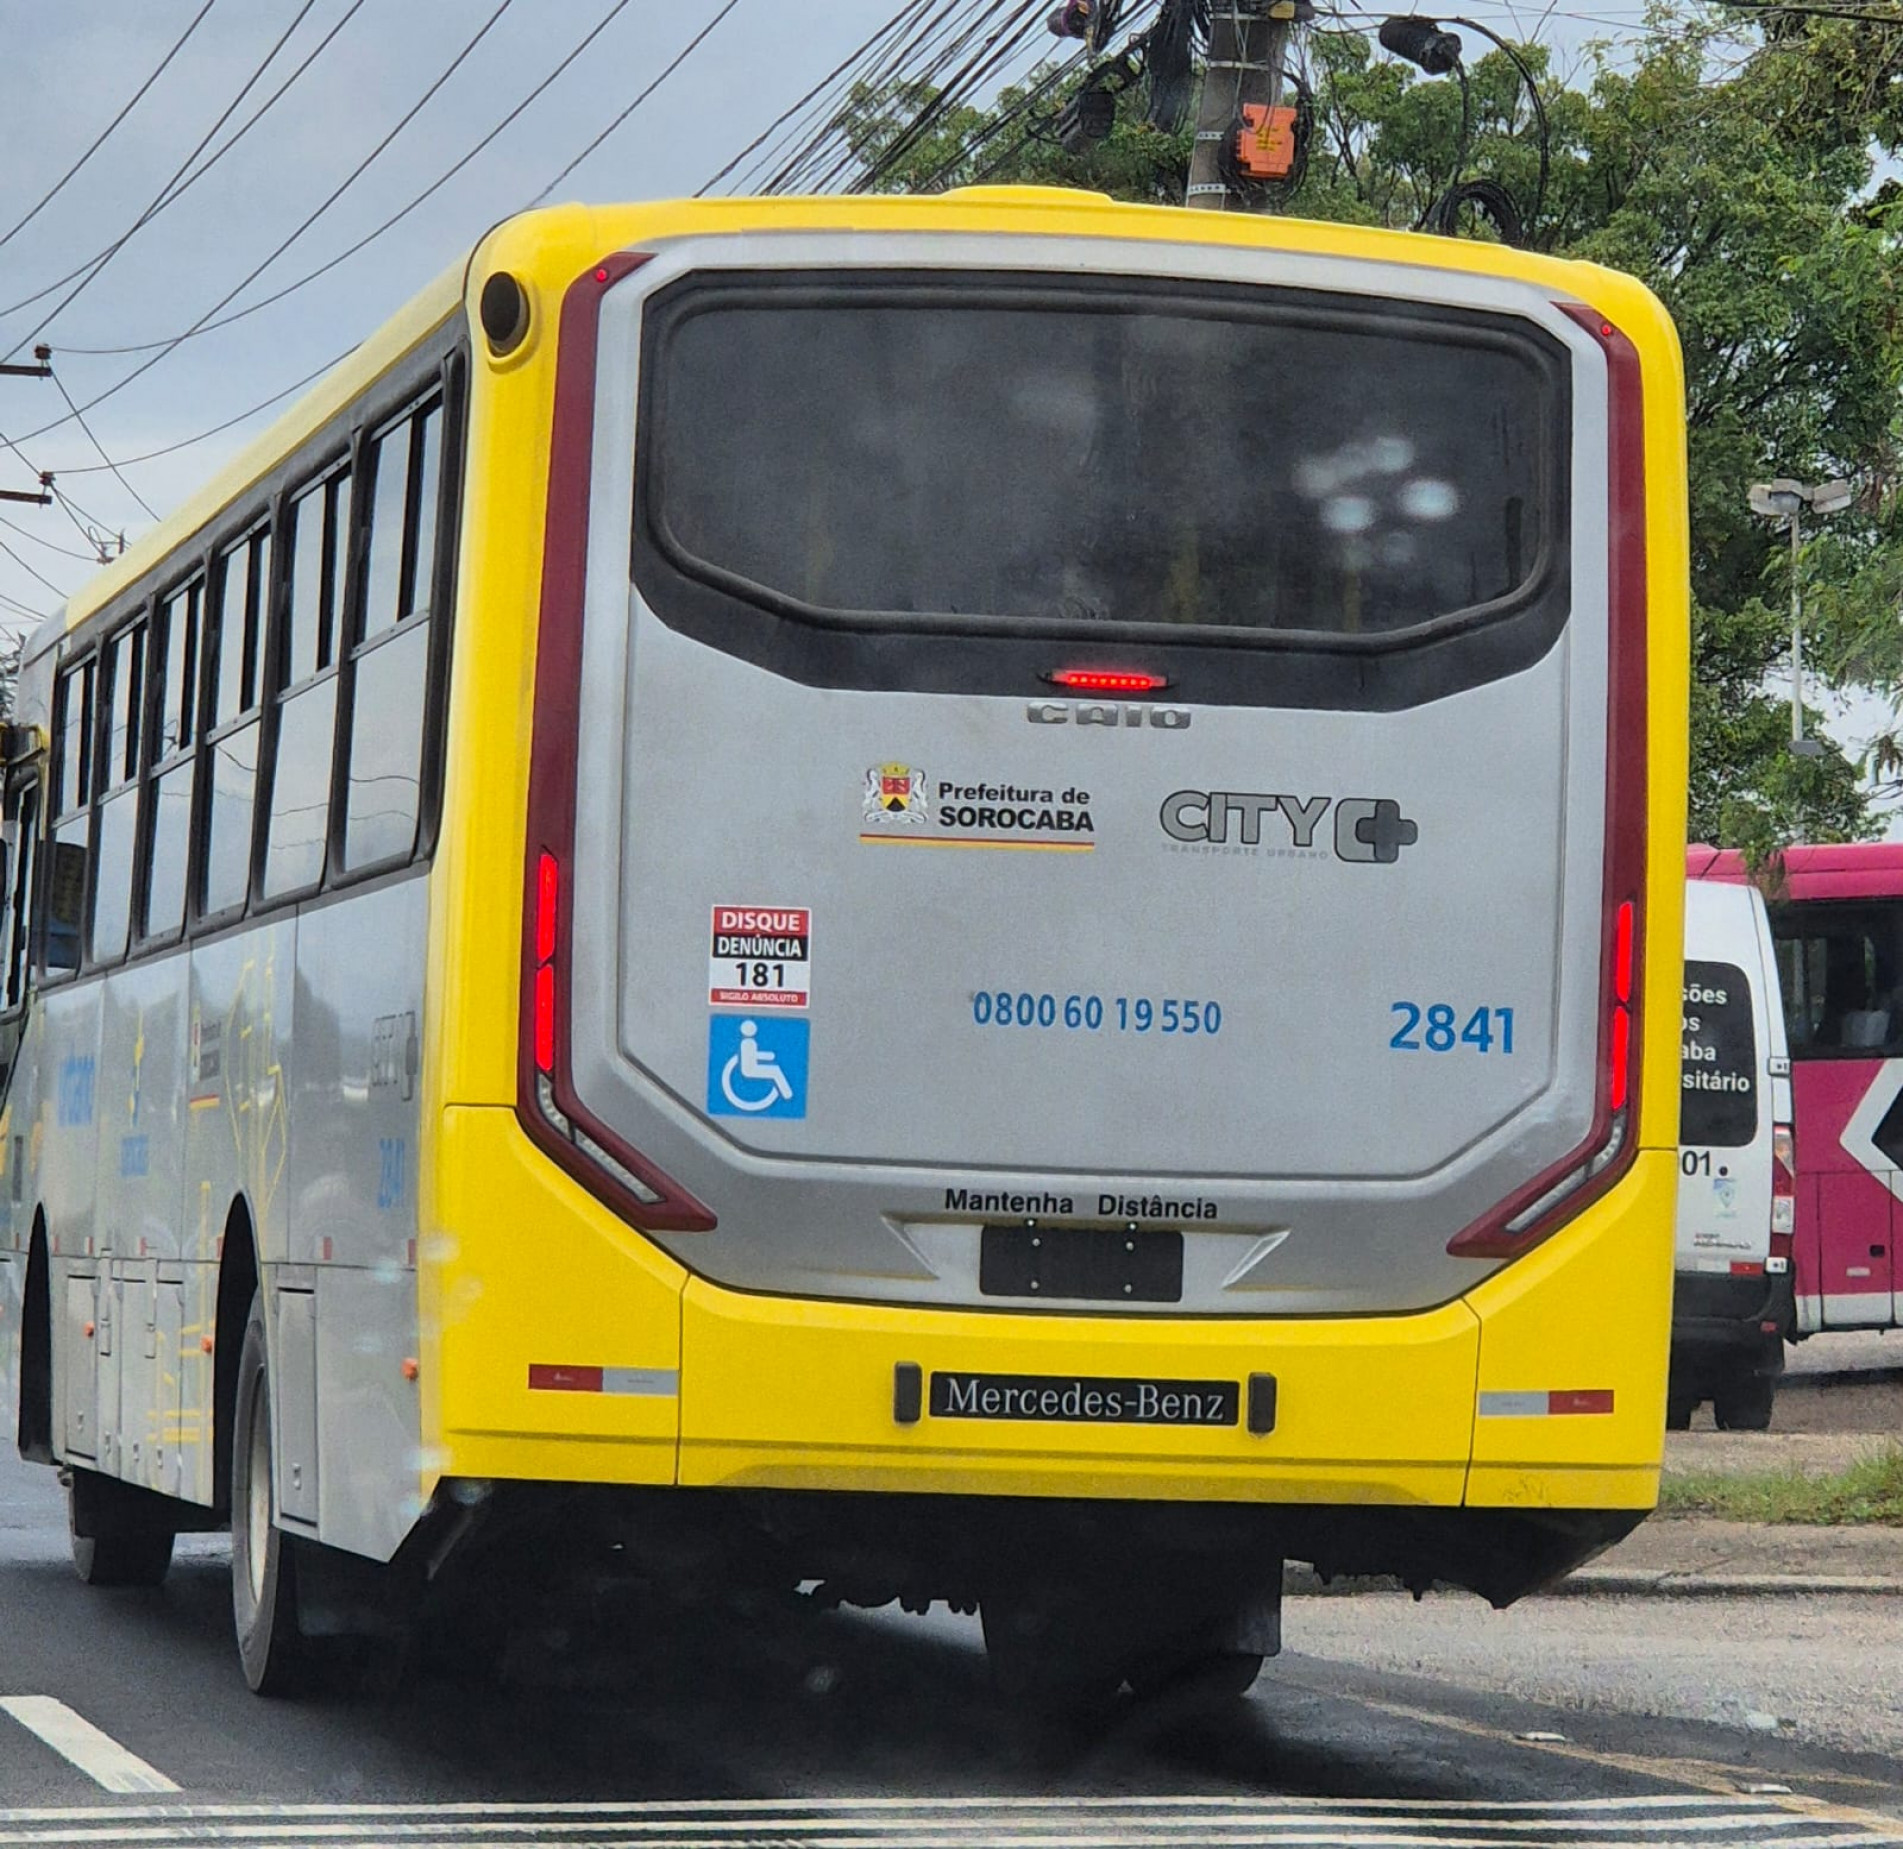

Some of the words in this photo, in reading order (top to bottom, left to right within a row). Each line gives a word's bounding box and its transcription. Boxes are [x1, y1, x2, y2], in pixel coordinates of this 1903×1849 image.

[1027, 701, 1191, 730] CAIO
[938, 782, 1053, 803] Prefeitura
[1061, 787, 1091, 805] de
[938, 806, 1095, 832] SOROCABA
[1159, 789, 1333, 848] CITY
[721, 911, 801, 933] DISQUE
[717, 934, 802, 958] DENÚNCIA
[735, 962, 784, 988] 181
[973, 991, 1056, 1027] 0800
[1063, 995, 1104, 1029] 60
[1161, 999, 1222, 1034] 550
[1389, 1001, 1514, 1054] 2841
[944, 1188, 1074, 1214] Mantenha
[1097, 1194, 1218, 1219] Distância
[946, 1378, 1225, 1421] Mercedes-Benz
